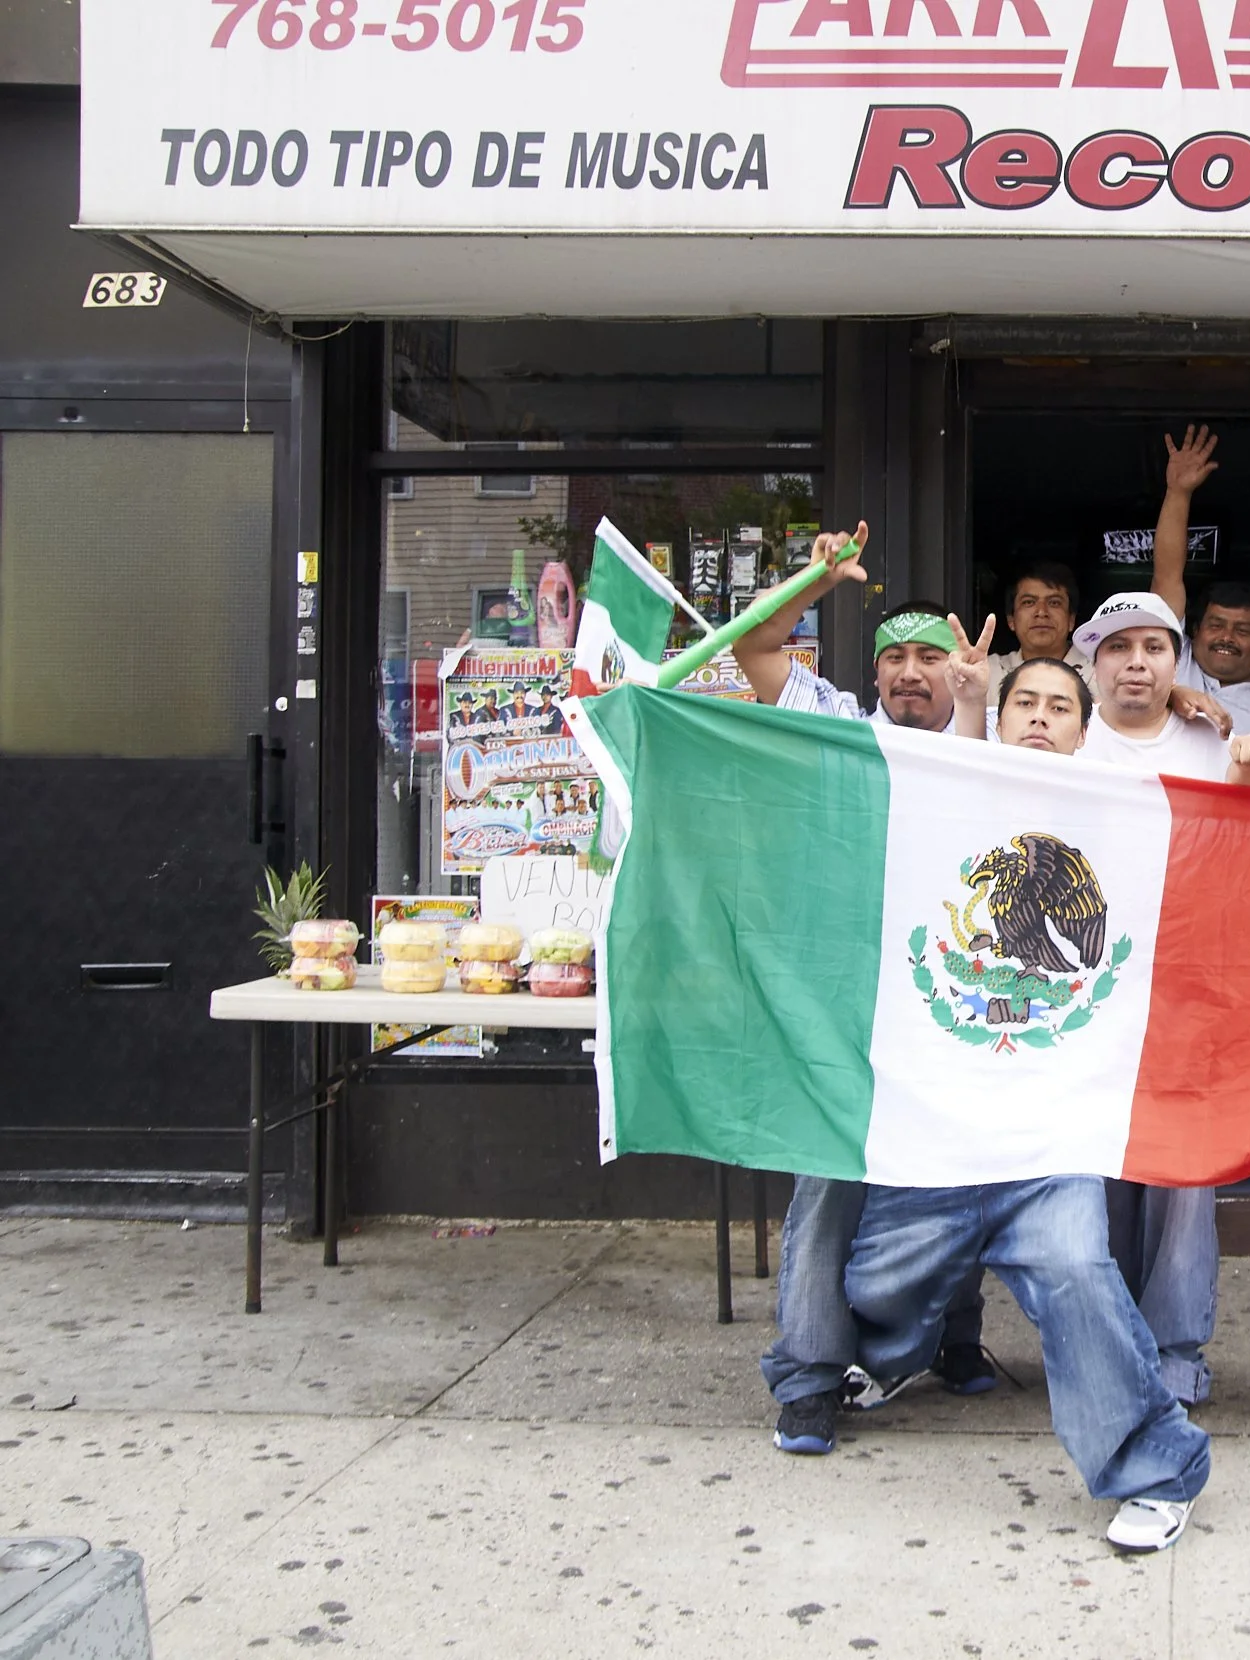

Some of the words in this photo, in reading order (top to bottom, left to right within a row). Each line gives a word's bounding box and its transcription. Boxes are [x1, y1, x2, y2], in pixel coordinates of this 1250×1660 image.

[213, 0, 585, 52] 768-5015
[160, 128, 309, 188] TODO
[330, 130, 452, 188] TIPO
[471, 131, 546, 188] DE
[564, 132, 769, 190] MUSICA
[91, 275, 162, 304] 683
